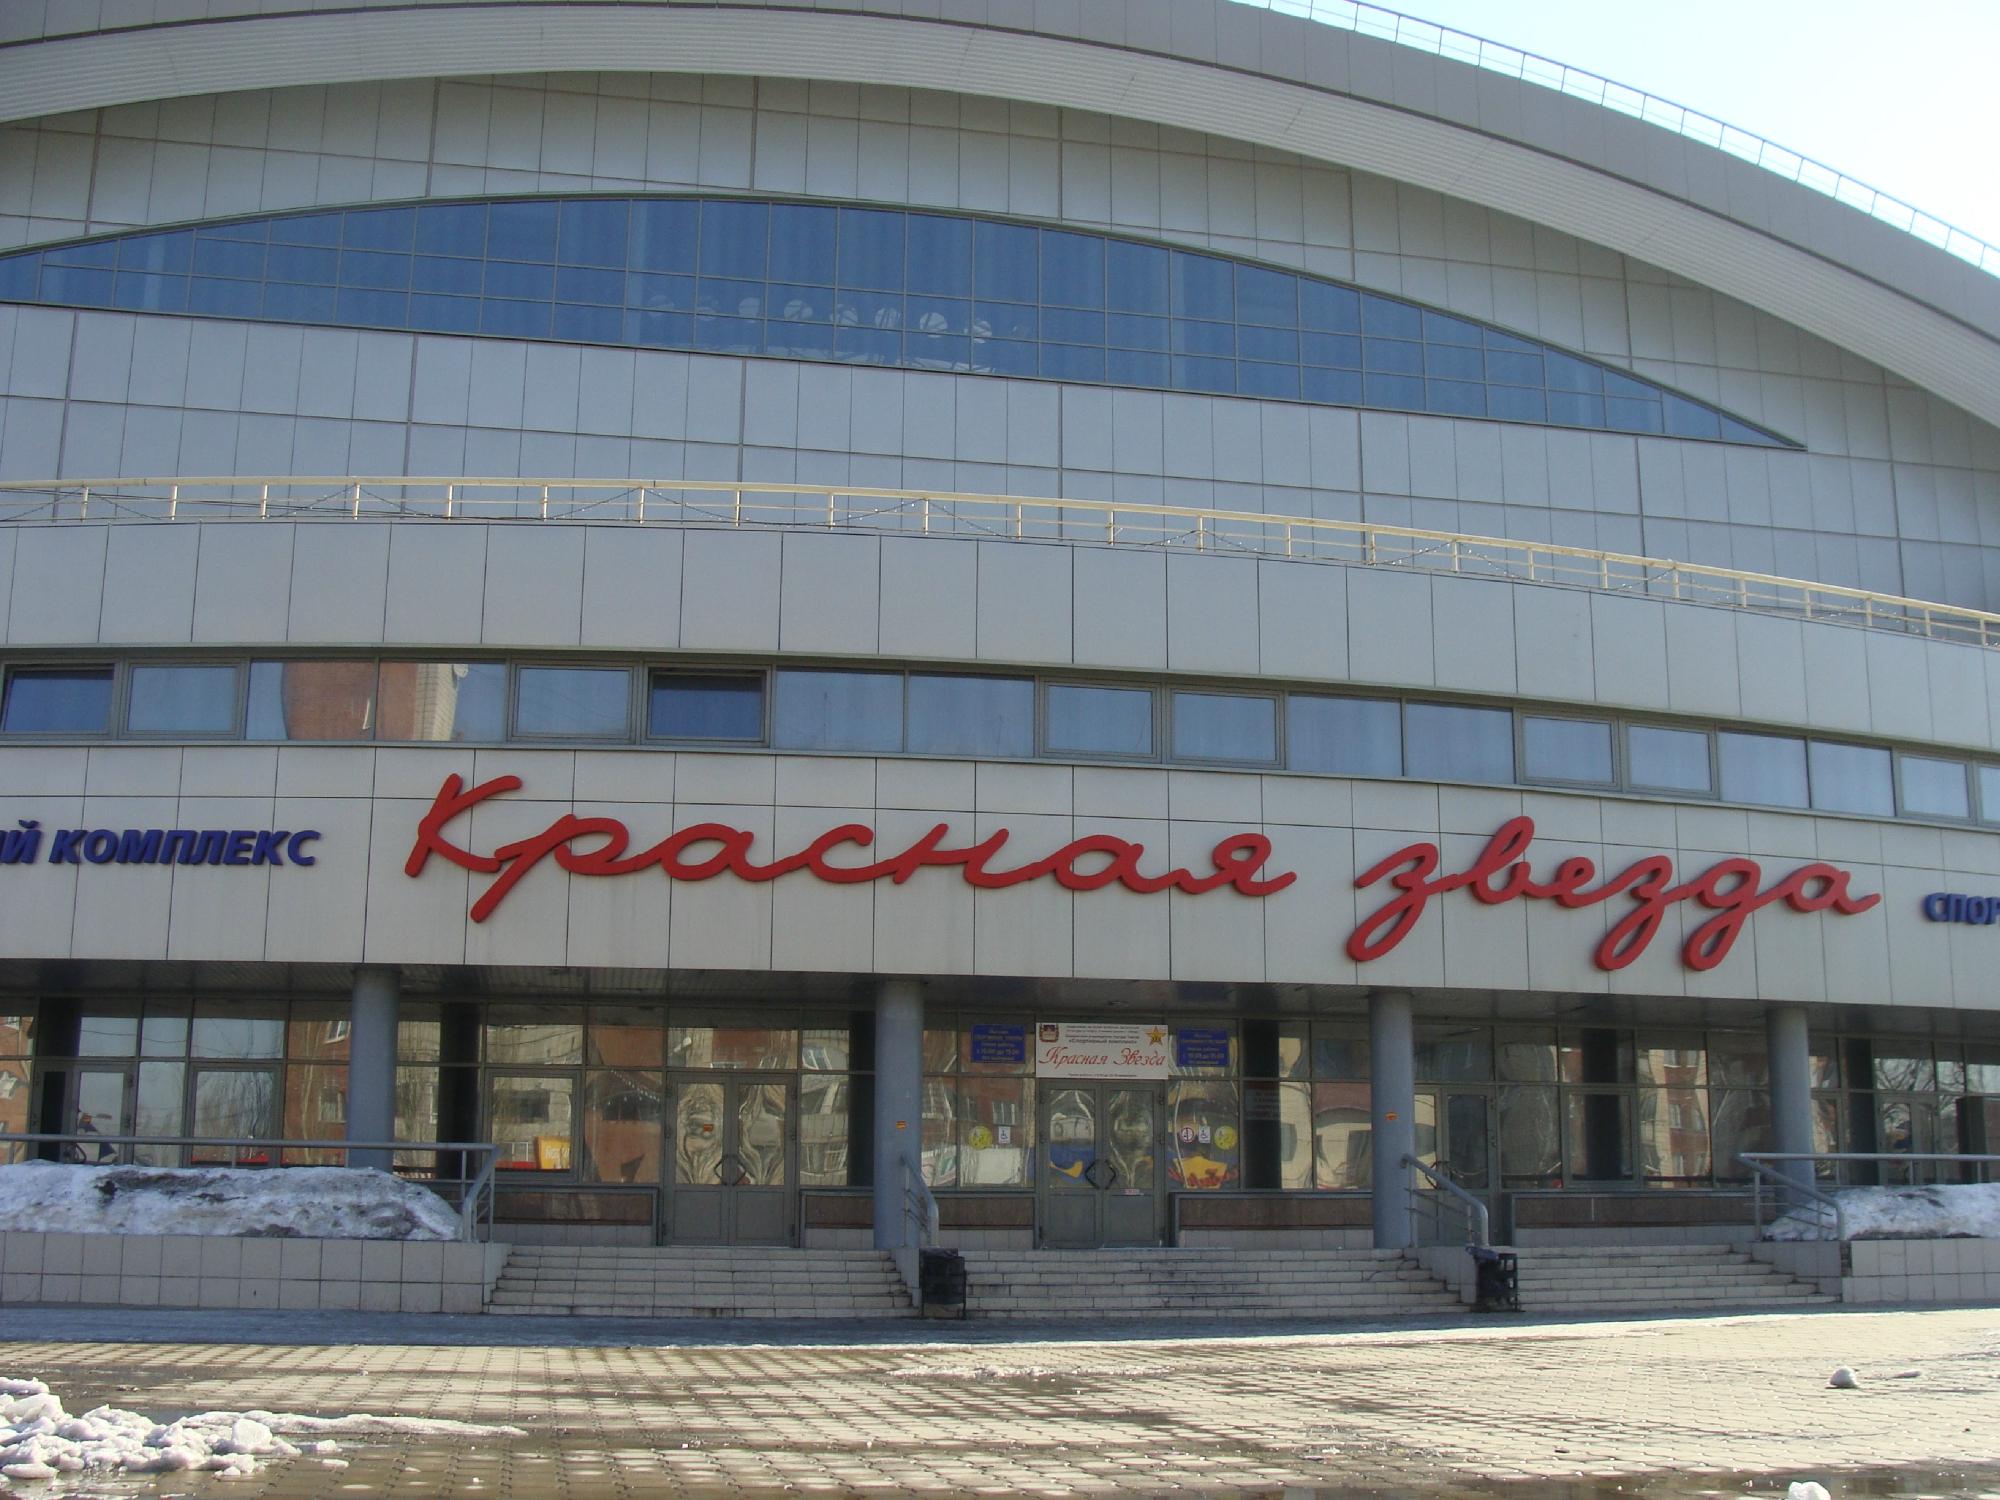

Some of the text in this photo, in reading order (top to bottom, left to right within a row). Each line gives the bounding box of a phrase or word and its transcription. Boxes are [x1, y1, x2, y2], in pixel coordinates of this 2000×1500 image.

[49, 829, 321, 865] КОМПЛЕКС
[404, 773, 1297, 922] Красная
[1039, 1047, 1108, 1069] Красная
[1113, 1047, 1166, 1066] Звезда
